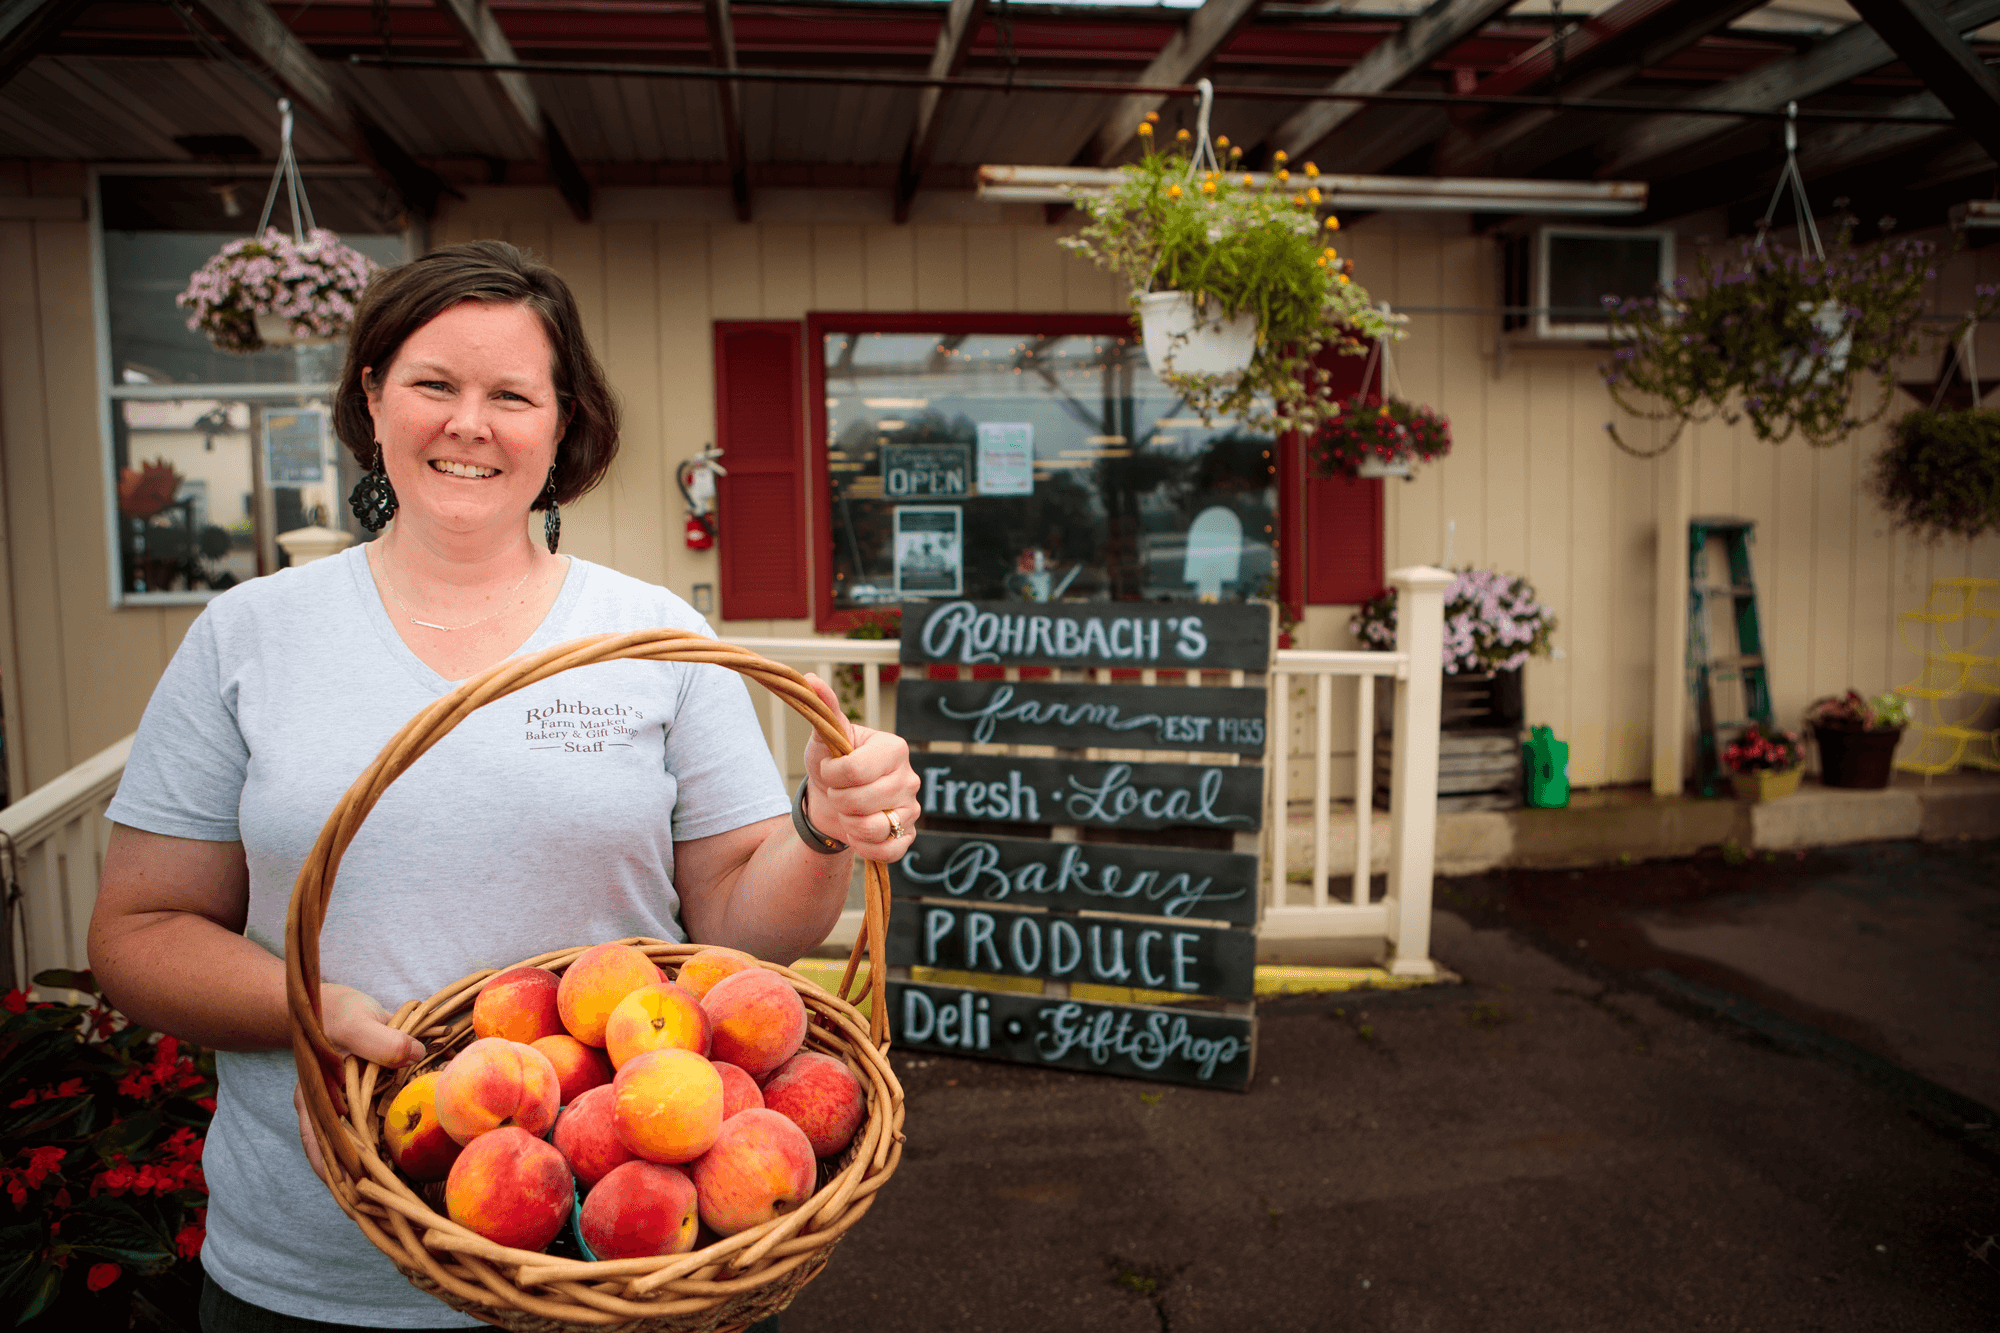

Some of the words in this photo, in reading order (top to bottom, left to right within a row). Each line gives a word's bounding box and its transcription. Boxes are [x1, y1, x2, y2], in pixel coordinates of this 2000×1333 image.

[889, 467, 964, 494] OPEN
[921, 600, 1208, 663] ROHRBACH'S
[525, 699, 644, 725] Rohrbach's
[525, 730, 568, 741] Bakery
[572, 730, 582, 739] &
[586, 728, 609, 739] Gift
[613, 725, 639, 740] Shop
[541, 720, 576, 730] Farm
[580, 718, 626, 730] Market
[938, 684, 1164, 744] farm
[1163, 715, 1209, 742] EST
[1217, 717, 1265, 745] 1955
[564, 740, 605, 753] Staff
[923, 766, 1041, 821] Fresh
[1066, 764, 1255, 824] Local
[901, 841, 1247, 918] Bakery
[925, 908, 1201, 990] PRODUCE
[903, 988, 991, 1050] Deli
